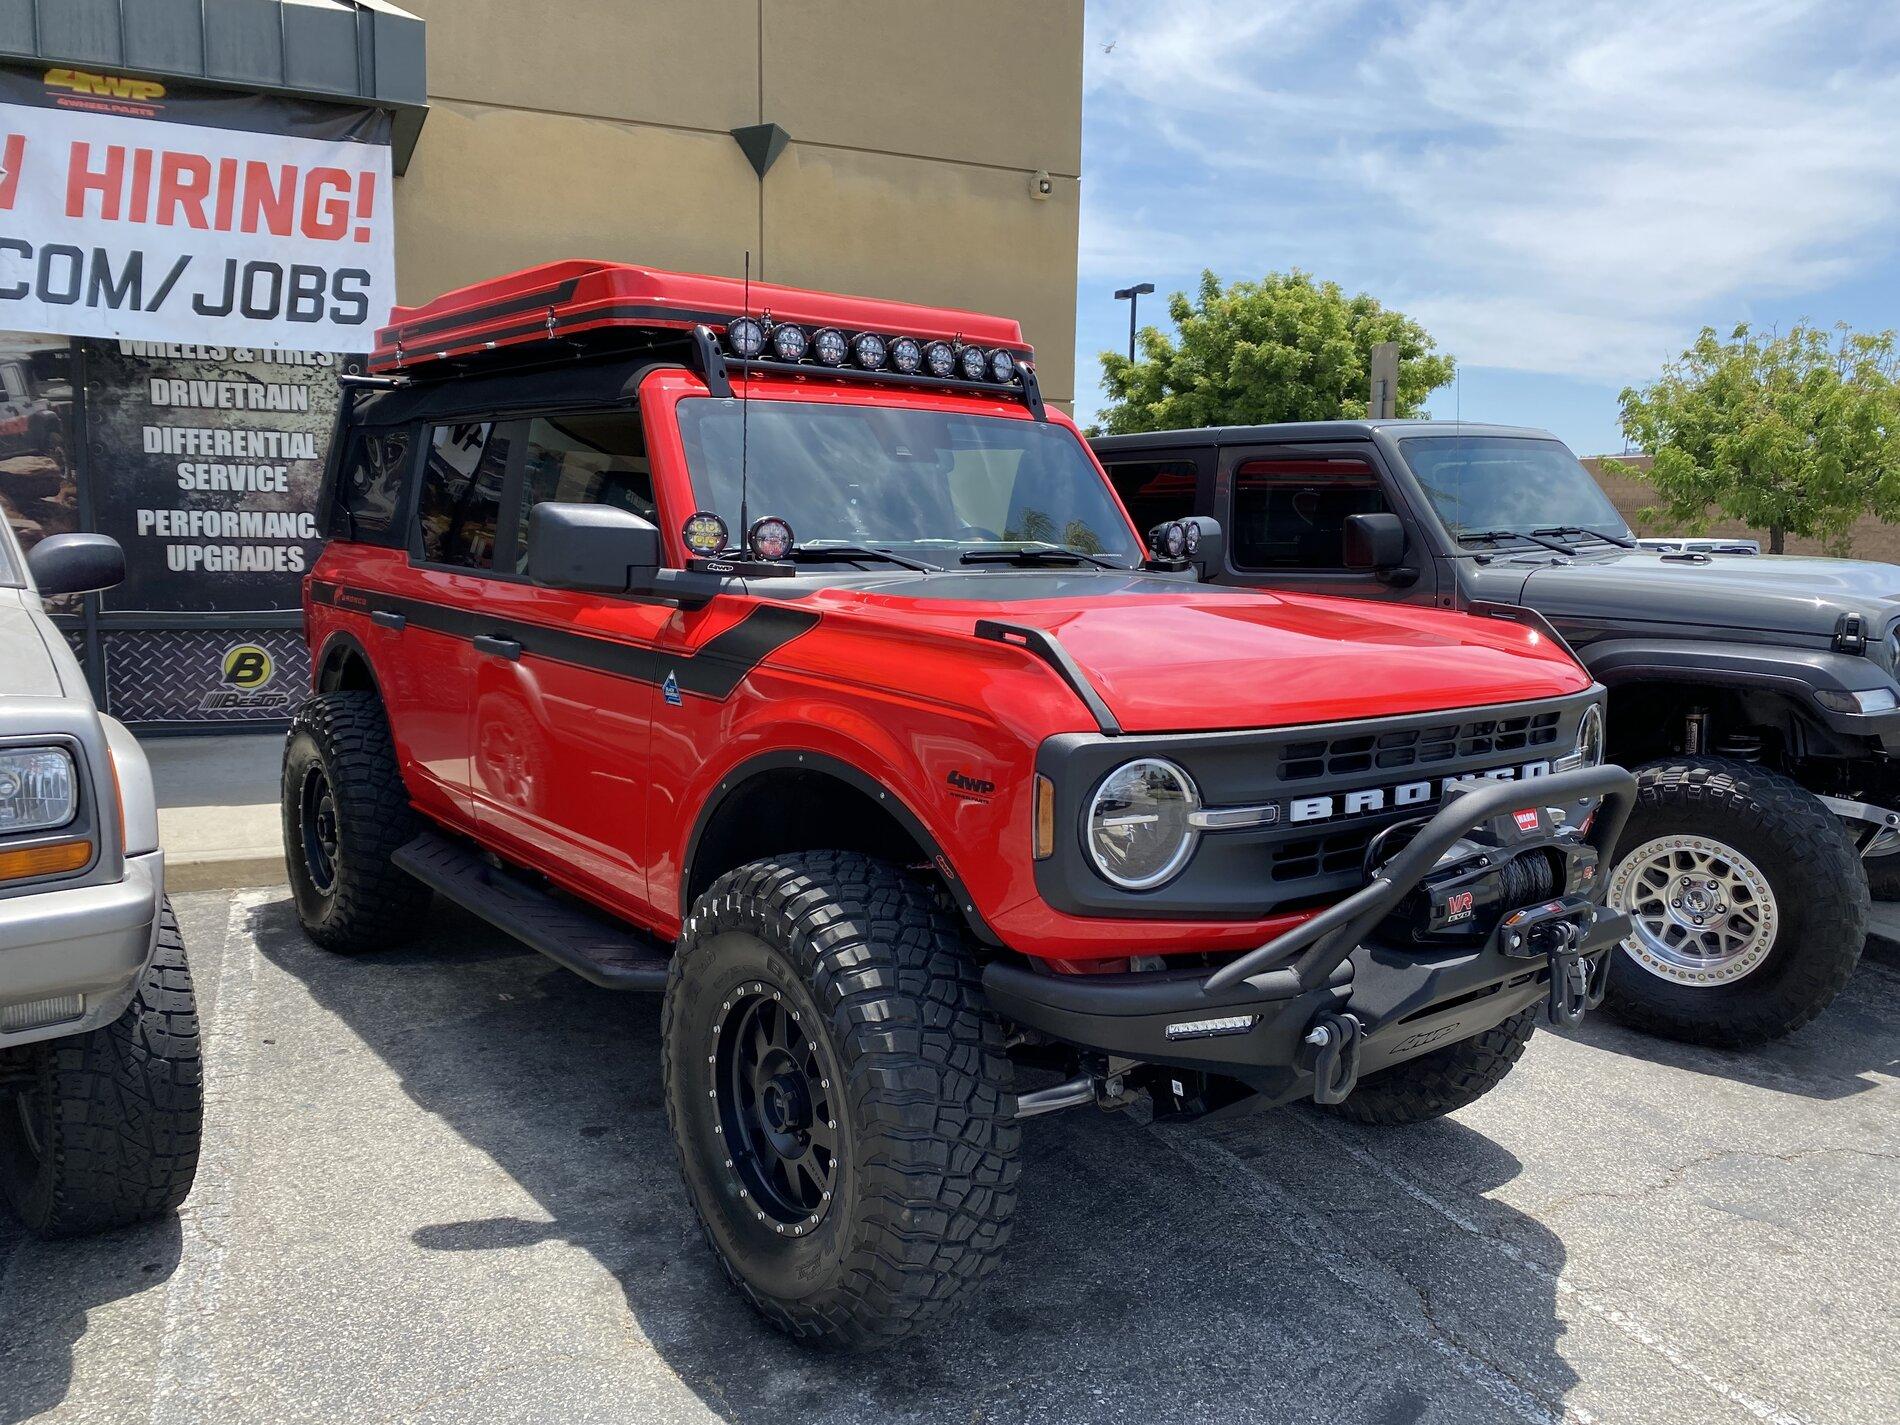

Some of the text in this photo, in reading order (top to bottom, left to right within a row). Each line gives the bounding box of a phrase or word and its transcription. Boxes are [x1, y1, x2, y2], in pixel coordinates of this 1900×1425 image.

[44, 68, 166, 100] 4WP
[65, 141, 376, 243] HIRING!
[150, 378, 308, 411] DRIVETRAIN
[143, 426, 318, 459] DIFFERENTIAL
[177, 462, 288, 492] SERVICE
[167, 545, 305, 572] UPGRADES
[223, 653, 265, 683] B
[1289, 761, 1550, 822] BROCO
[1516, 812, 1536, 823] WARN
[1449, 892, 1473, 914] VR
